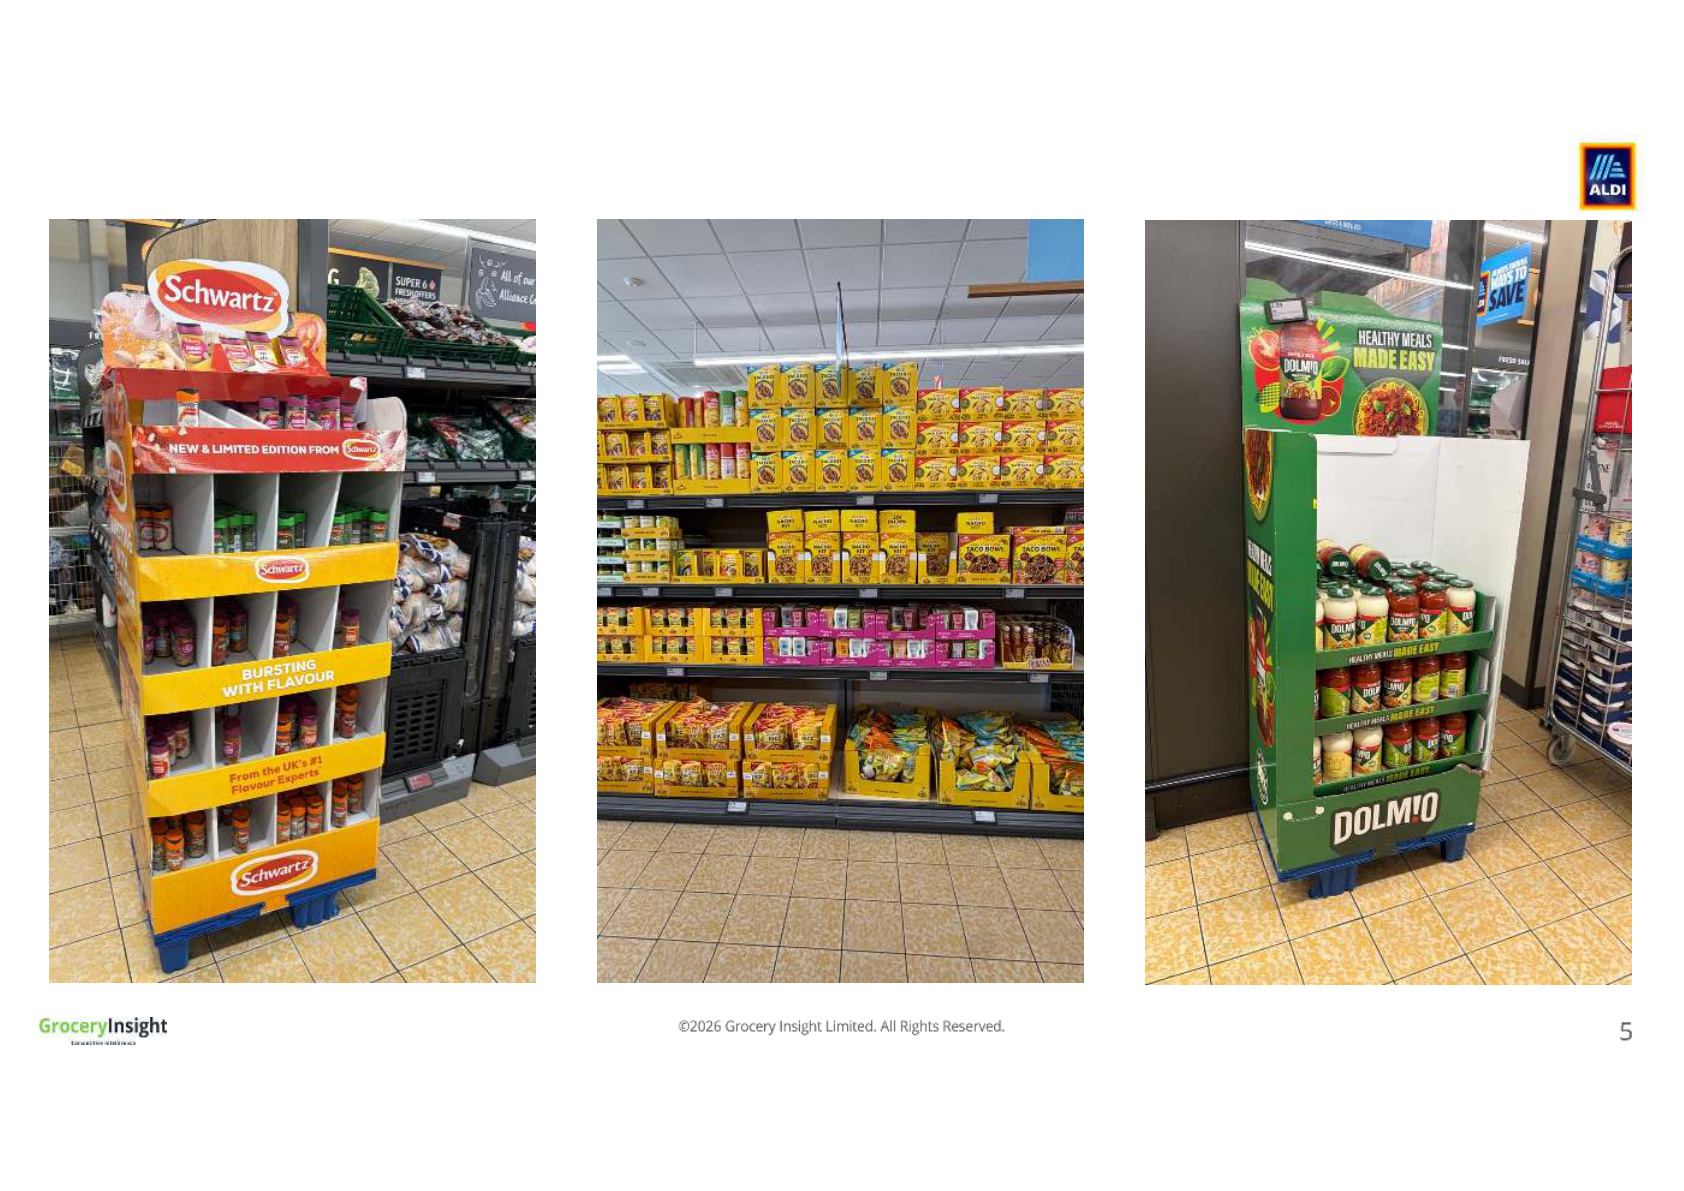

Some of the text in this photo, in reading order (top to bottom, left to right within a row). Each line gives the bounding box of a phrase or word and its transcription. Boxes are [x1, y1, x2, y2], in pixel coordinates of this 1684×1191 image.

[395, 276, 429, 289] SUPER 6
[501, 269, 513, 282] All
[513, 271, 524, 286] of
[164, 275, 275, 314] Schwartz
[394, 287, 437, 300] FRESH OFFERS
[499, 287, 529, 304] Alliance
[1489, 280, 1525, 311] SAVE
[1359, 329, 1432, 350] HEALTHY MEALS
[1354, 347, 1436, 373] MADE EASY
[169, 443, 199, 454] NEW
[202, 443, 210, 454] &
[212, 444, 260, 454] LIMITED
[262, 445, 306, 454] EDITION
[309, 446, 339, 454] FROM
[260, 564, 304, 577] Schwartz
[1349, 642, 1440, 664] HEALTHY MEALS MADE EASY
[242, 659, 316, 681] BURSTING
[222, 670, 335, 698] WITH FLAVOUR
[1346, 705, 1436, 730] HEALTHY MEALS MADE EASY
[229, 756, 323, 784] From the UK's #1
[1385, 770, 1410, 782] MADE
[1410, 765, 1431, 777] EASY
[231, 769, 319, 795] Flavour Experts
[241, 858, 313, 885] Schwartz
